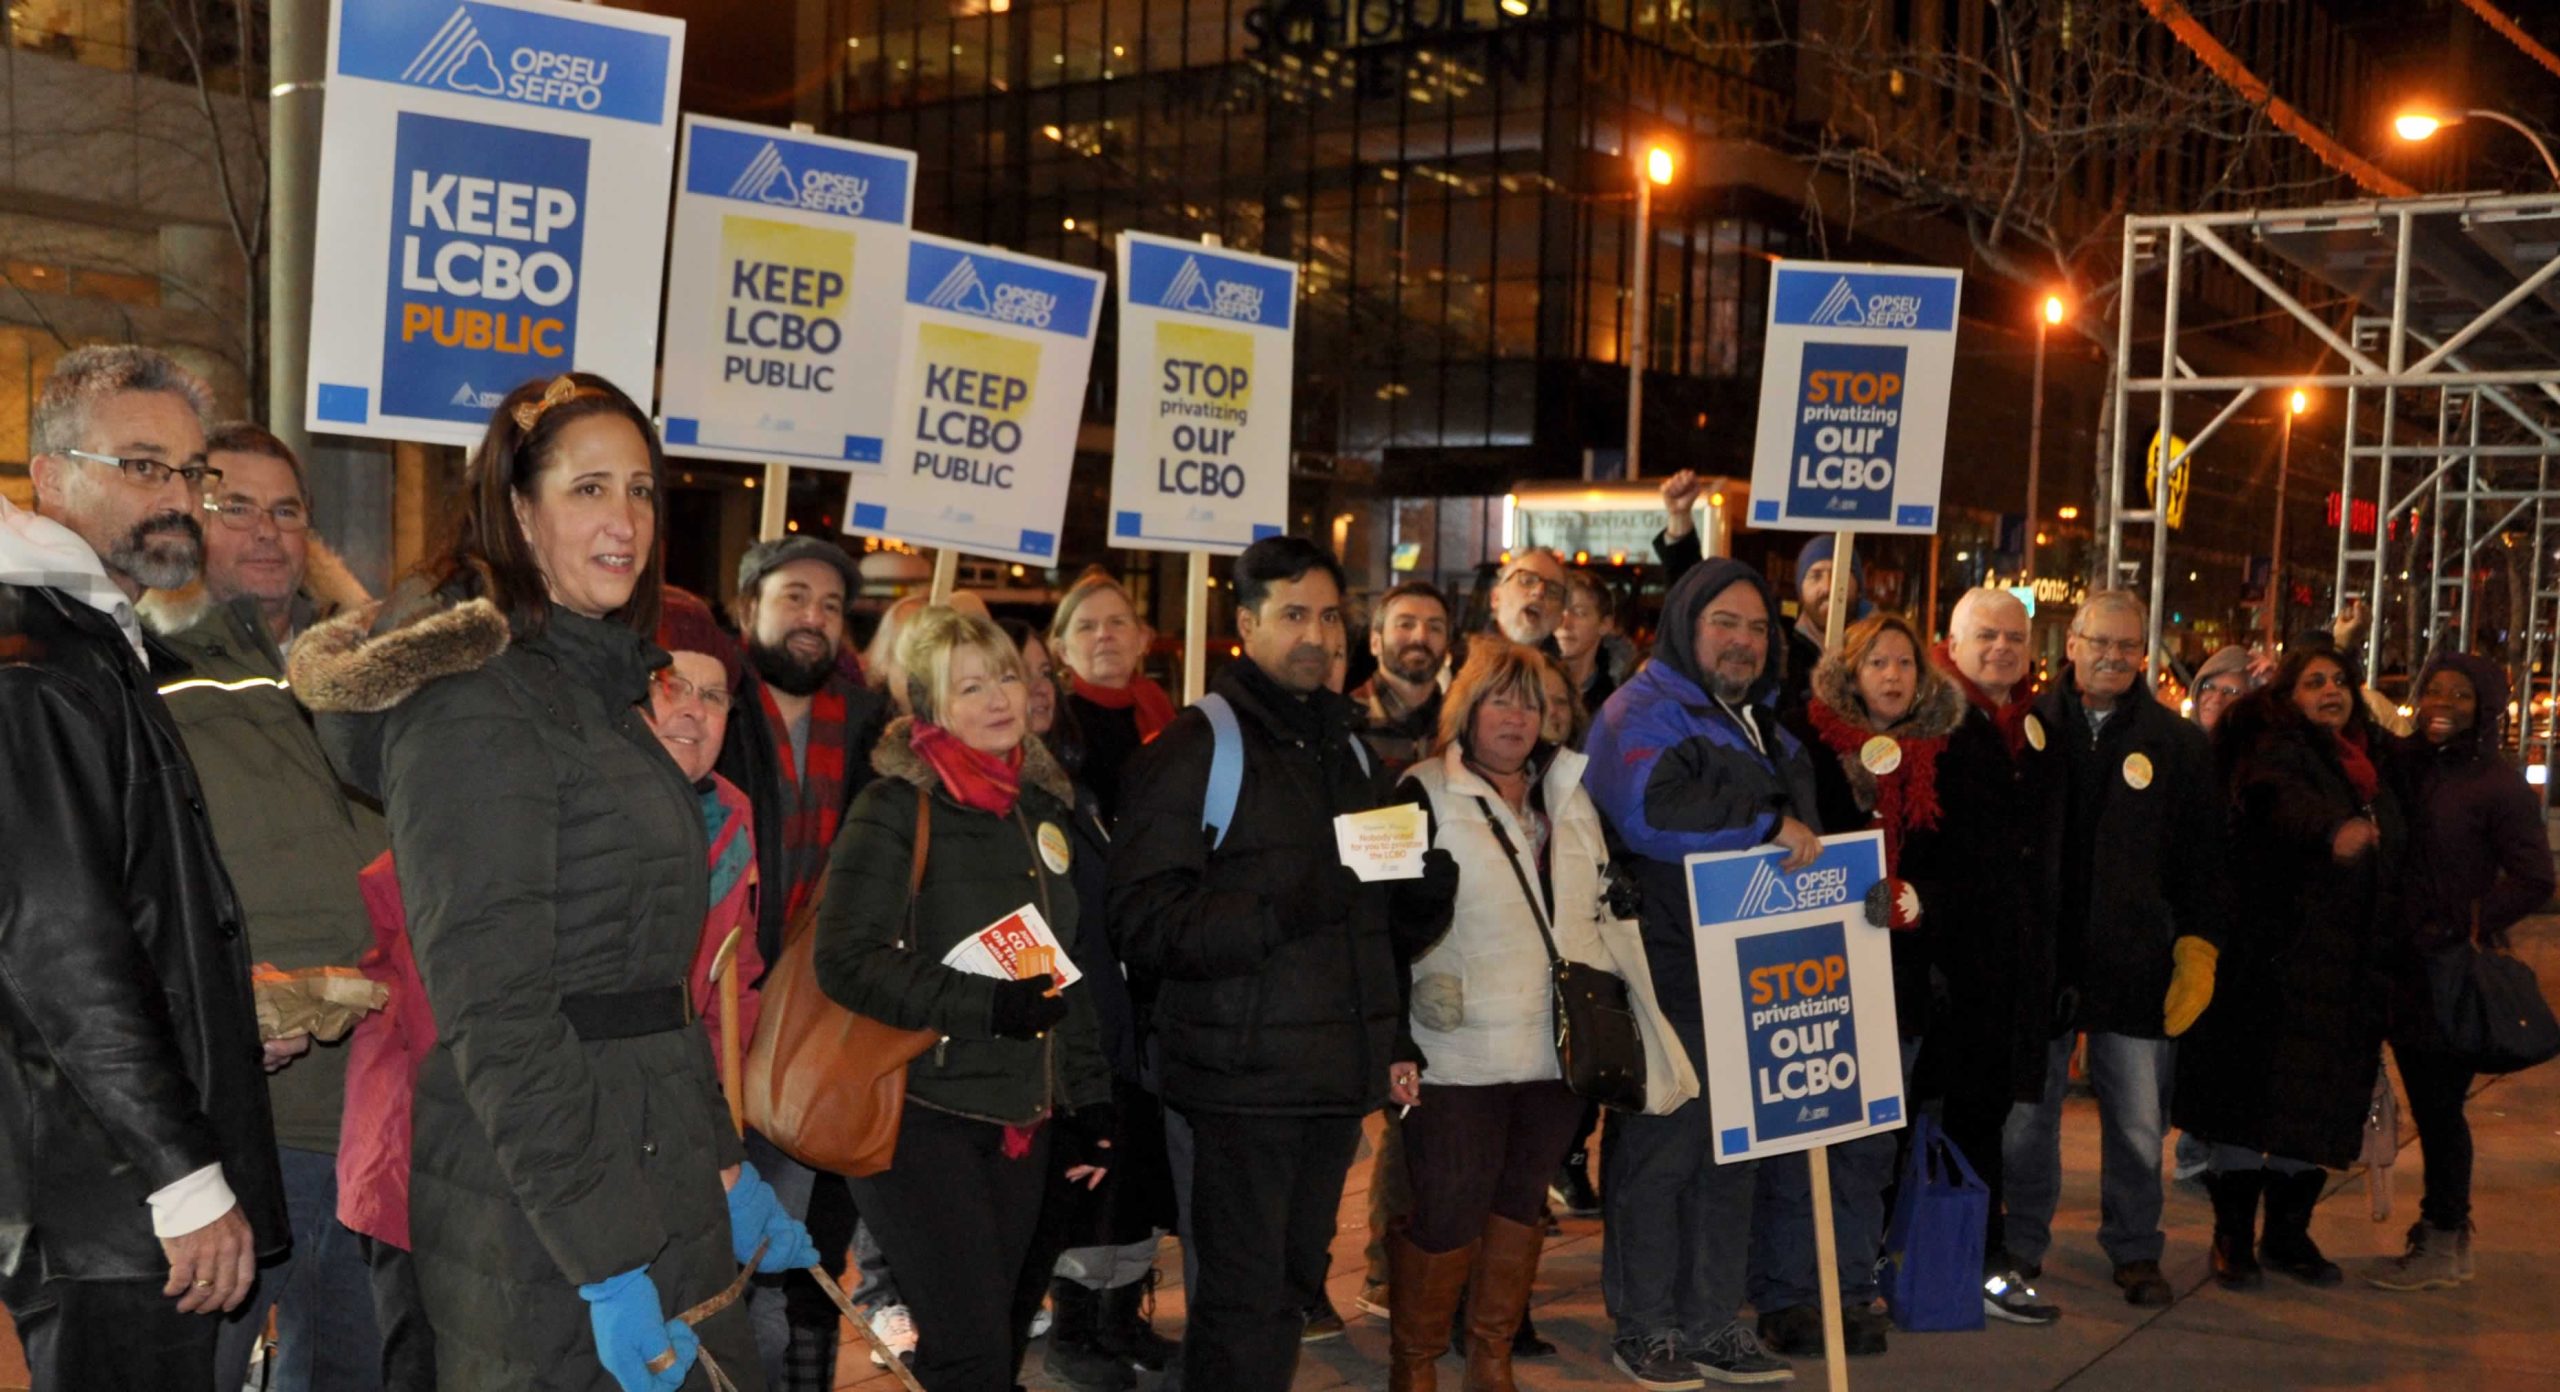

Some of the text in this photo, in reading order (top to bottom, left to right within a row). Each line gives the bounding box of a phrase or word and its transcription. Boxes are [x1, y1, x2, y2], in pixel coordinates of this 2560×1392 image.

[511, 47, 608, 85] OPSEU
[507, 74, 602, 110] SEFPO
[803, 169, 869, 198] OPSEU
[409, 170, 576, 243] KEEP
[800, 190, 864, 215] SEFPO
[402, 235, 573, 306] LCBO
[733, 260, 844, 308] KEEP
[992, 301, 1051, 327] SEFPO
[994, 283, 1057, 311] OPSEU
[1868, 295, 1921, 314] OPSEU
[402, 303, 565, 358] PUBLIC
[726, 306, 841, 354] LCBO
[1866, 311, 1918, 328] SEFPO
[724, 356, 834, 392] PUBLIC
[925, 363, 1027, 411] KEEP
[1163, 358, 1248, 399] STOP
[1807, 370, 1902, 405] STOP
[916, 406, 1022, 454] LCBO
[1161, 399, 1247, 426] privatizing
[1803, 404, 1897, 427] privatizing
[1173, 425, 1235, 455] our
[1815, 426, 1883, 454] our
[913, 451, 1014, 489] PUBLIC
[1159, 457, 1245, 498] LCBO
[1798, 456, 1892, 490] LCBO
[1796, 868, 1847, 891] OPSEU
[1797, 886, 1847, 909] SEFPO
[991, 929, 1007, 947] ON
[1749, 955, 1846, 1005] STOP
[1752, 995, 1850, 1030] privatizing
[1770, 1020, 1840, 1058] our
[1759, 1053, 1857, 1104] LCBO
